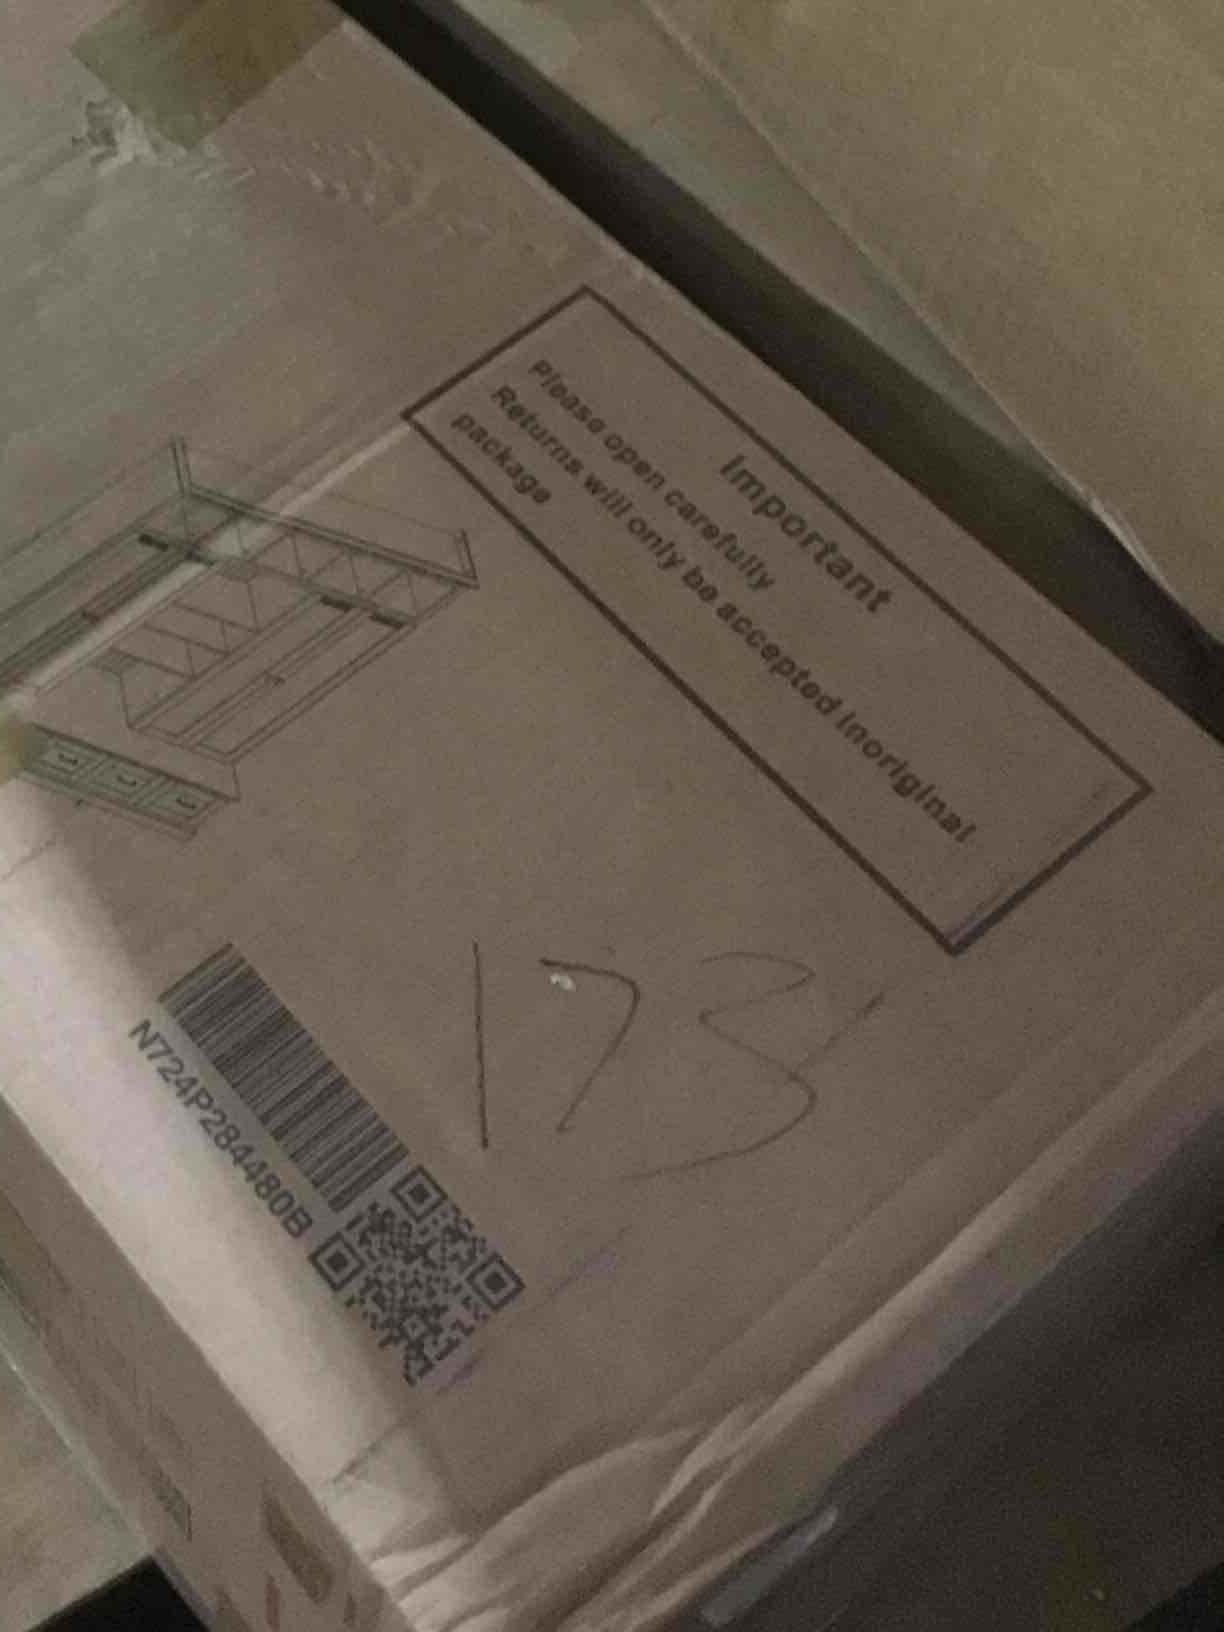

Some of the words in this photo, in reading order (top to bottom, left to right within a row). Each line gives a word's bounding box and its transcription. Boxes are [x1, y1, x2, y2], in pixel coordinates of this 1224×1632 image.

[450, 413, 552, 504] package
[489, 385, 584, 476] Returns
[584, 473, 633, 518] will
[627, 516, 686, 571] only
[682, 566, 719, 603] be
[716, 602, 843, 715] accepted
[528, 359, 607, 435] Please
[603, 433, 666, 491] open
[664, 489, 775, 591] carefully
[720, 453, 892, 614] Important
[127, 1018, 313, 1239] N724P284480B
